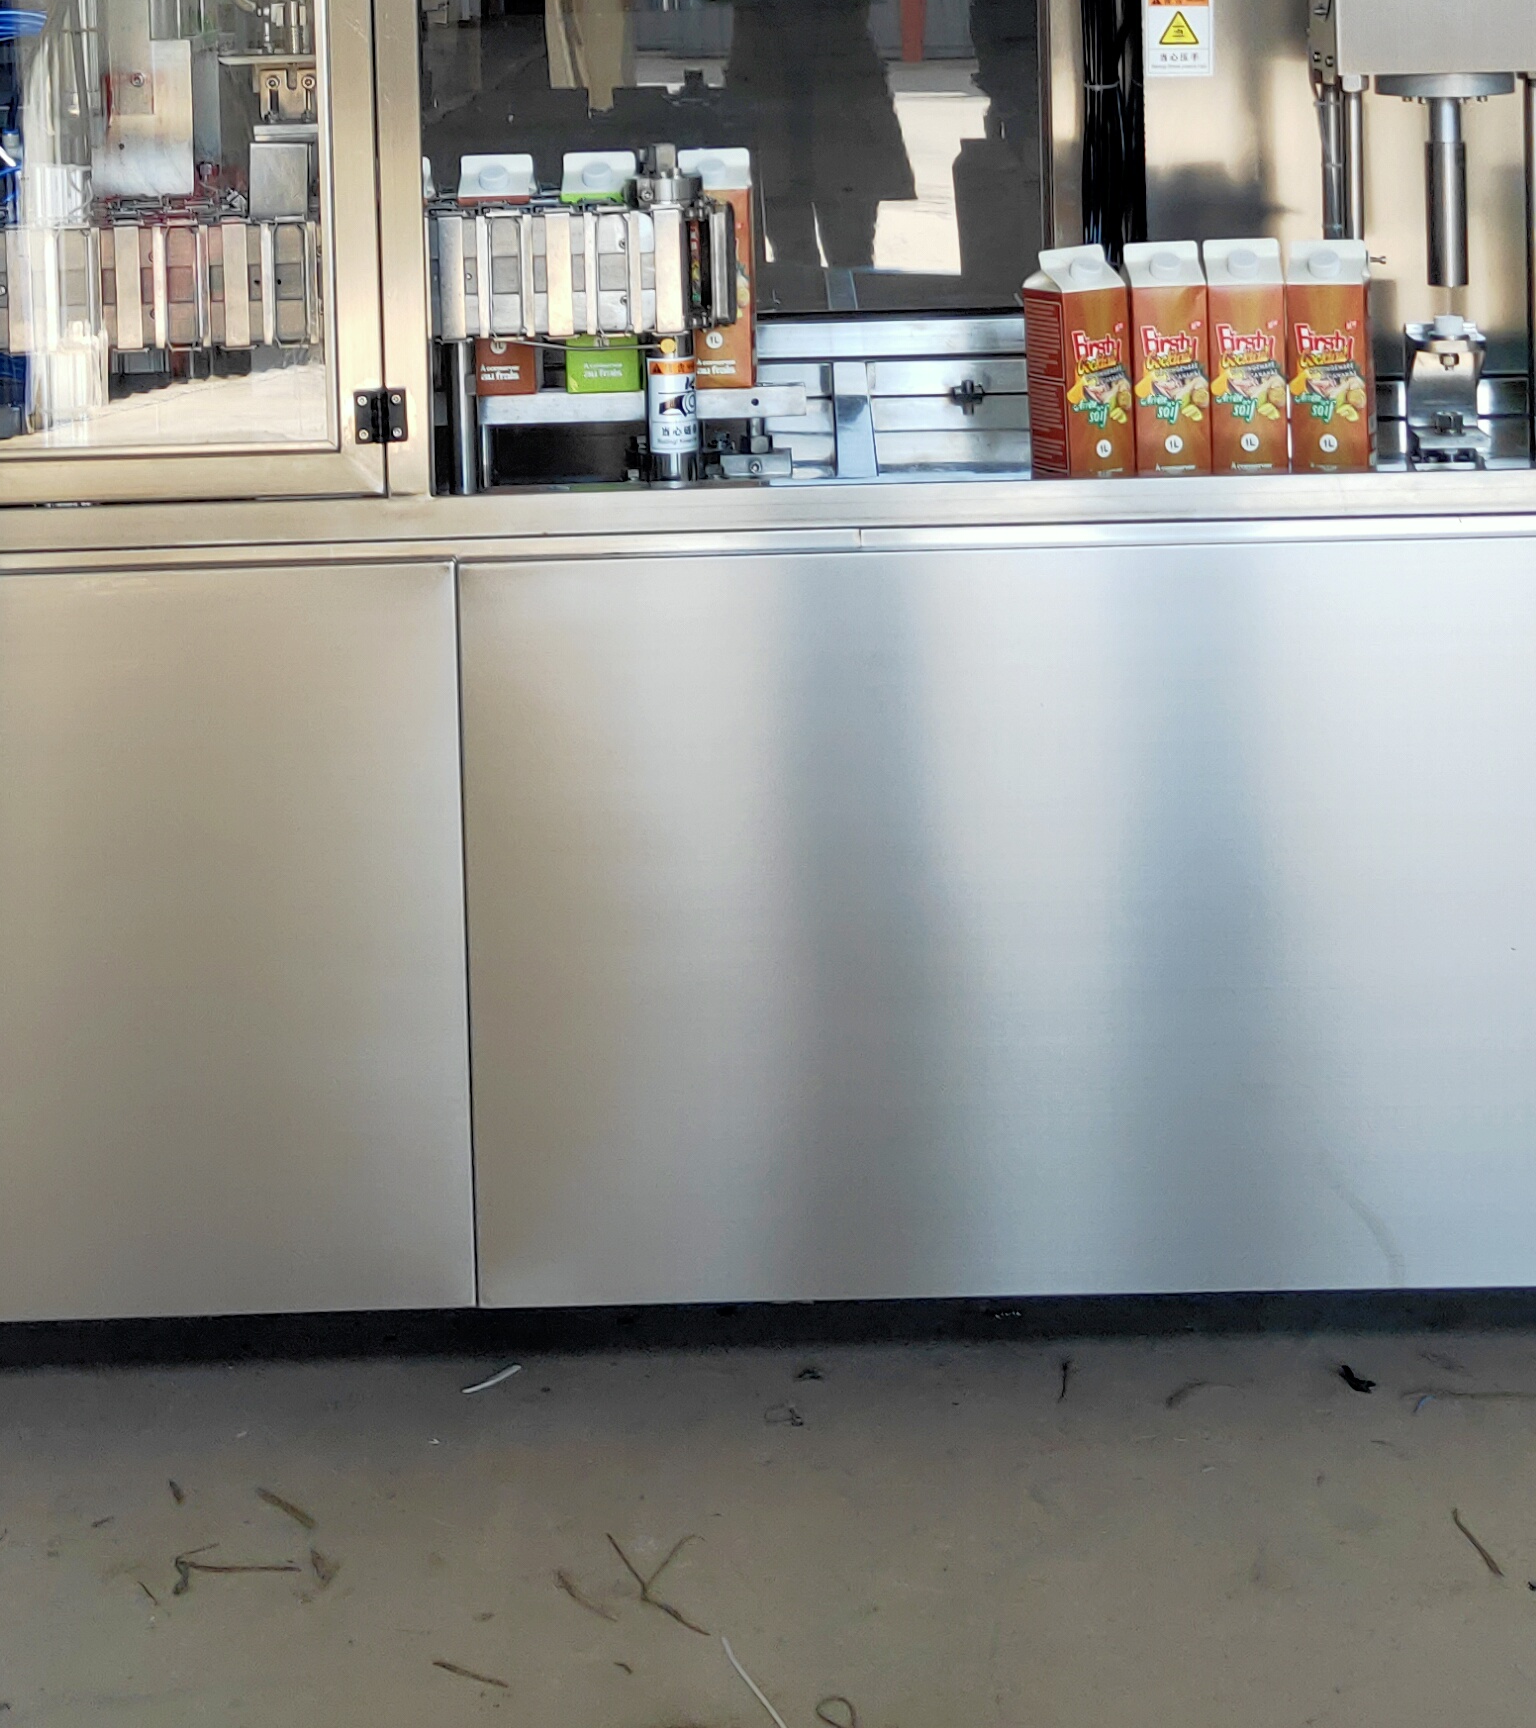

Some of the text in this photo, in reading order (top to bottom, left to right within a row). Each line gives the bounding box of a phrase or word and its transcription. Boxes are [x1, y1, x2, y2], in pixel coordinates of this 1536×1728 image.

[1088, 402, 1110, 429] soif
[1157, 398, 1183, 424] soif
[1233, 397, 1259, 423] soif
[1312, 397, 1337, 423] soif
